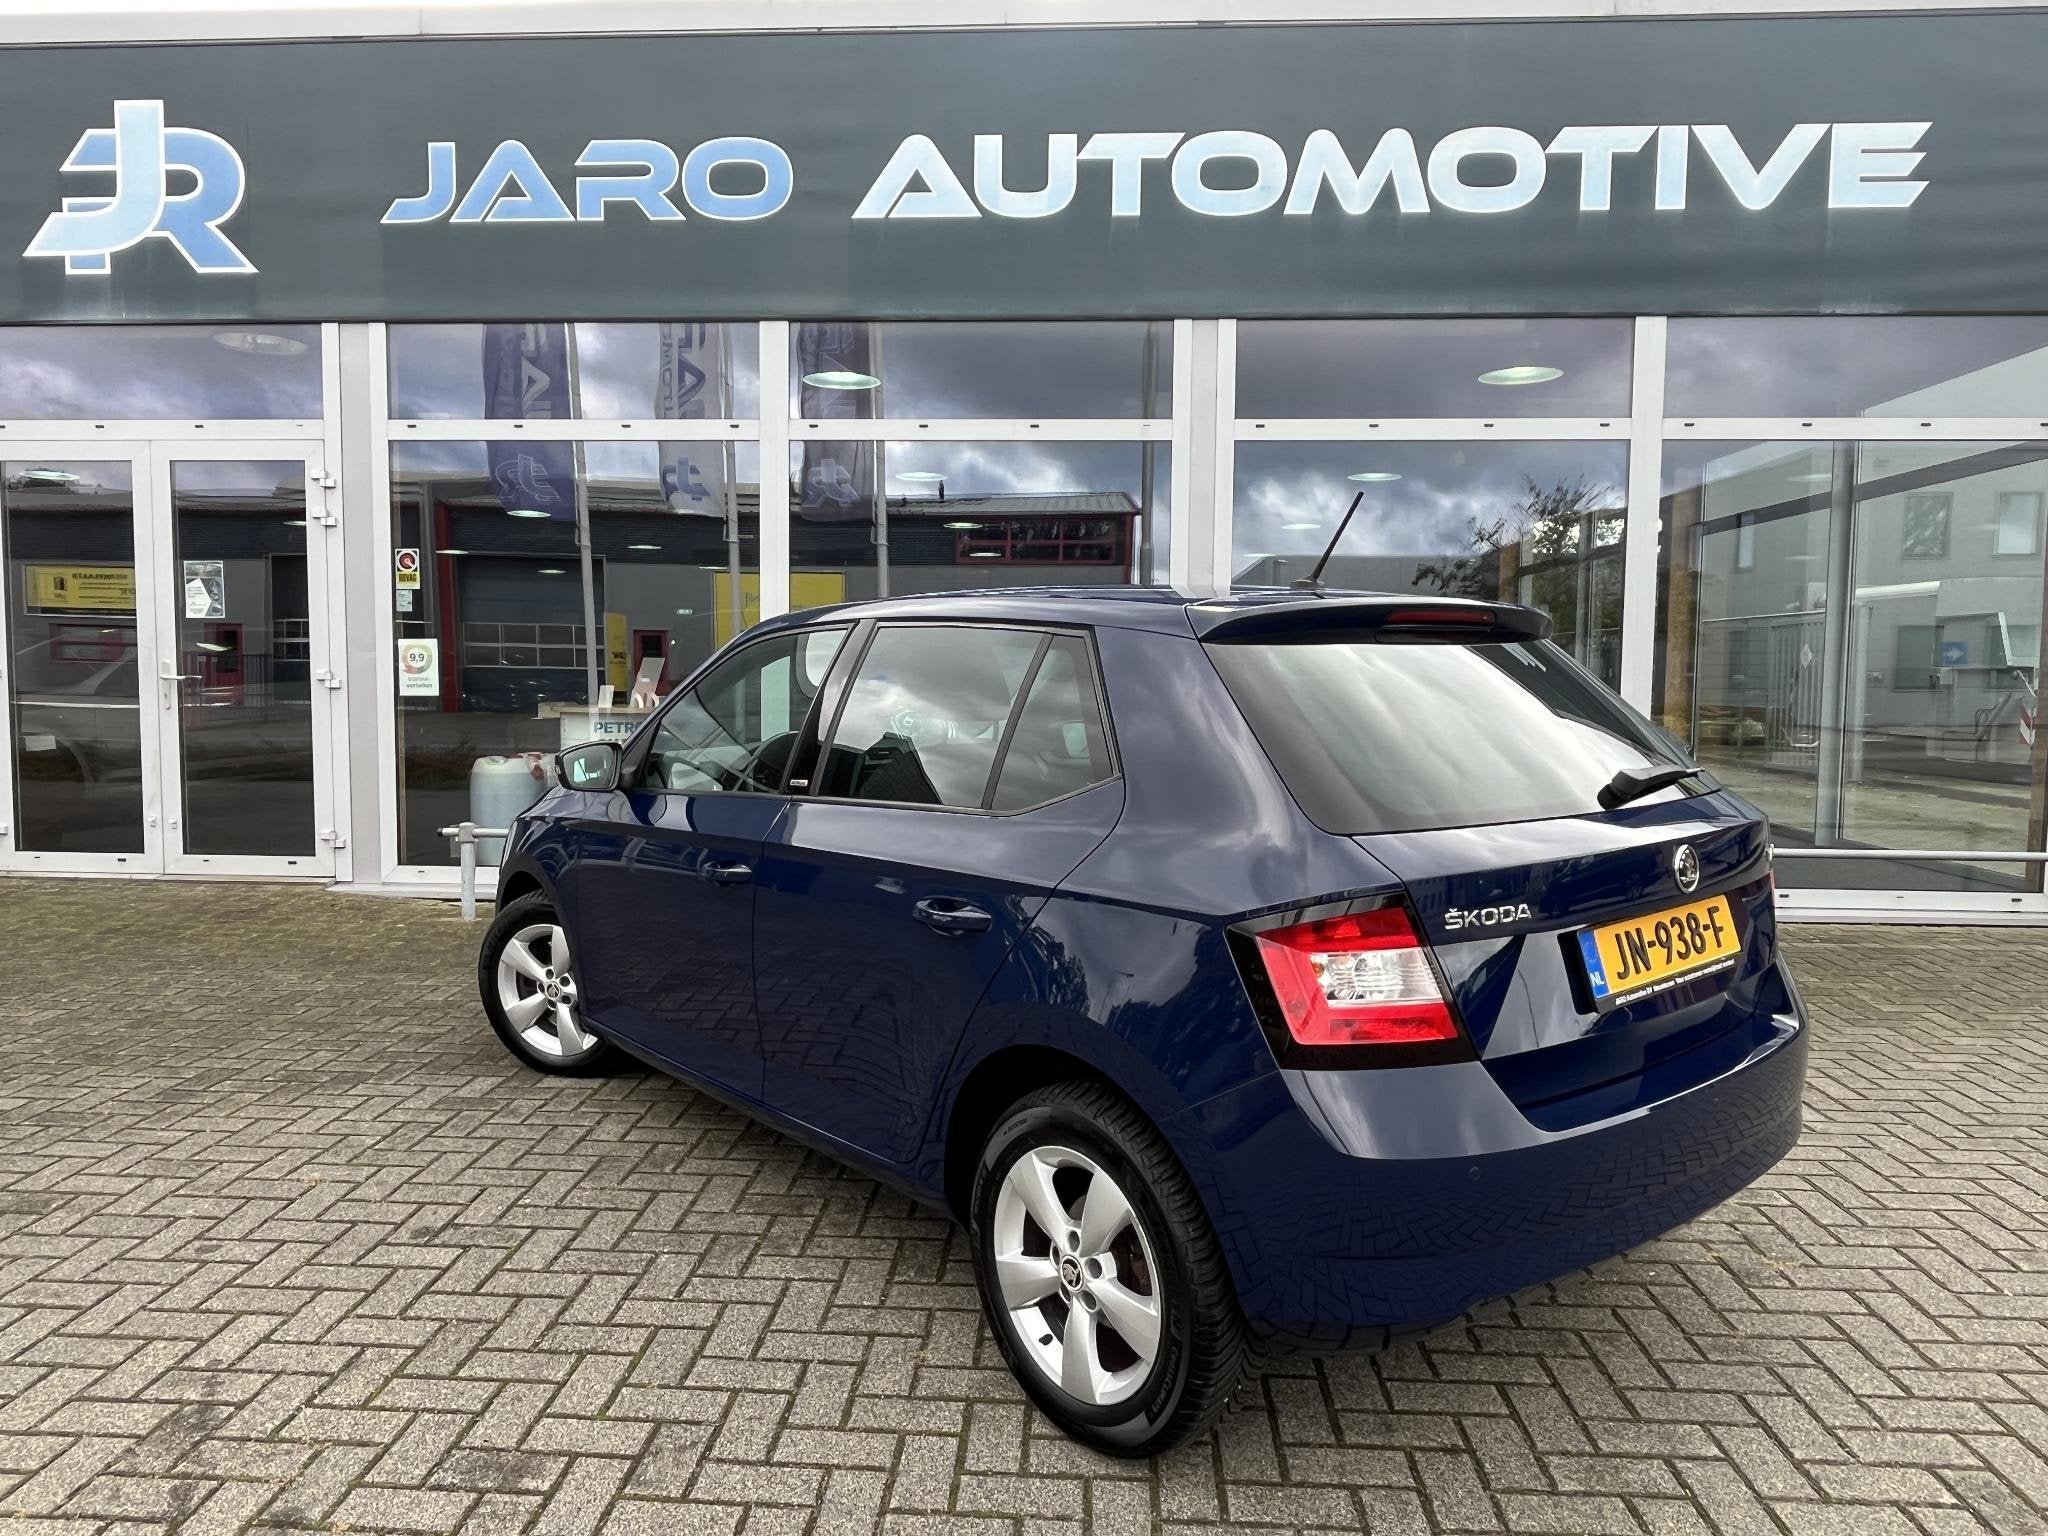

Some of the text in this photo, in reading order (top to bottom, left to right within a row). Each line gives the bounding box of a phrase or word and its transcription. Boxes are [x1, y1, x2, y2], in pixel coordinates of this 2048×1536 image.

[380, 121, 1933, 223] JARO AUTOMOTIVE
[409, 653, 425, 663] 9,9
[1444, 903, 1532, 930] ŠKODA
[1615, 905, 1724, 980] JN-938-F
[1590, 971, 1605, 986] NL
